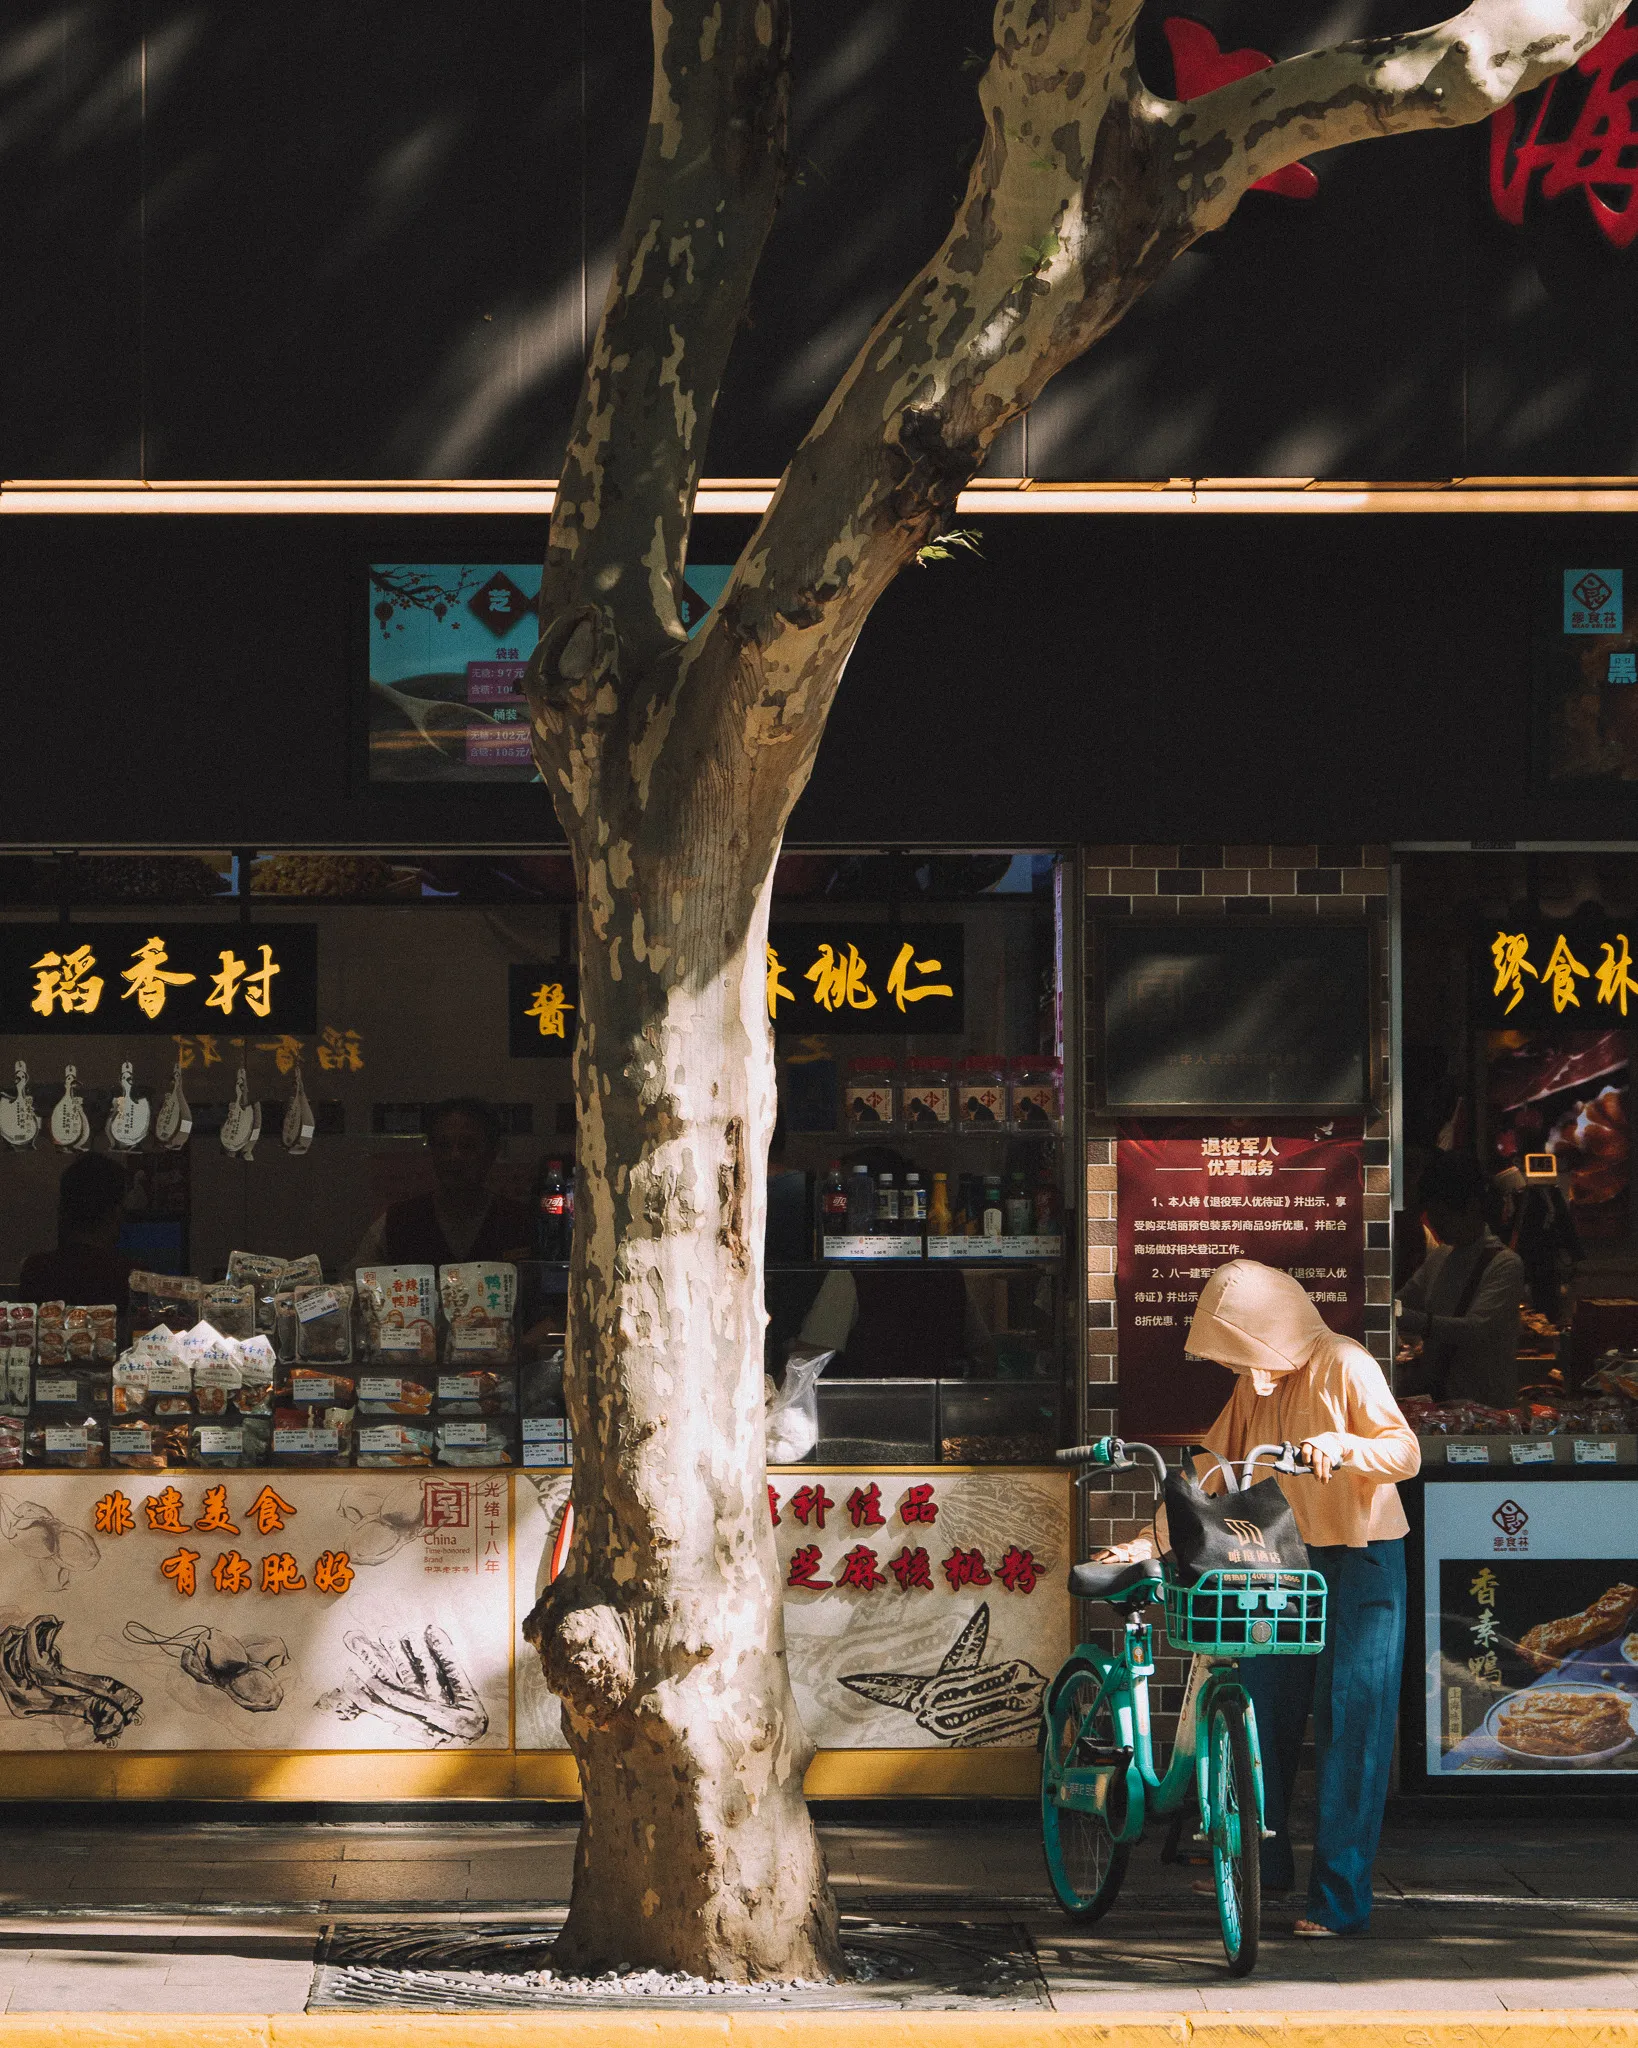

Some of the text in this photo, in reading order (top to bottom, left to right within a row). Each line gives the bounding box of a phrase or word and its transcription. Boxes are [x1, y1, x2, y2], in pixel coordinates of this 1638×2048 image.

[30, 936, 281, 1019] 稻香村
[1201, 1137, 1280, 1157] 退役军人
[1207, 1159, 1274, 1176] 优享服务
[1134, 1244, 1246, 1256] 商场做好相关登记工作。
[95, 1484, 297, 1536] 非遗美食
[424, 1534, 457, 1545] China
[484, 1482, 501, 1575] 光绪十八年
[787, 1544, 1049, 1594] 芝麻核桃粉
